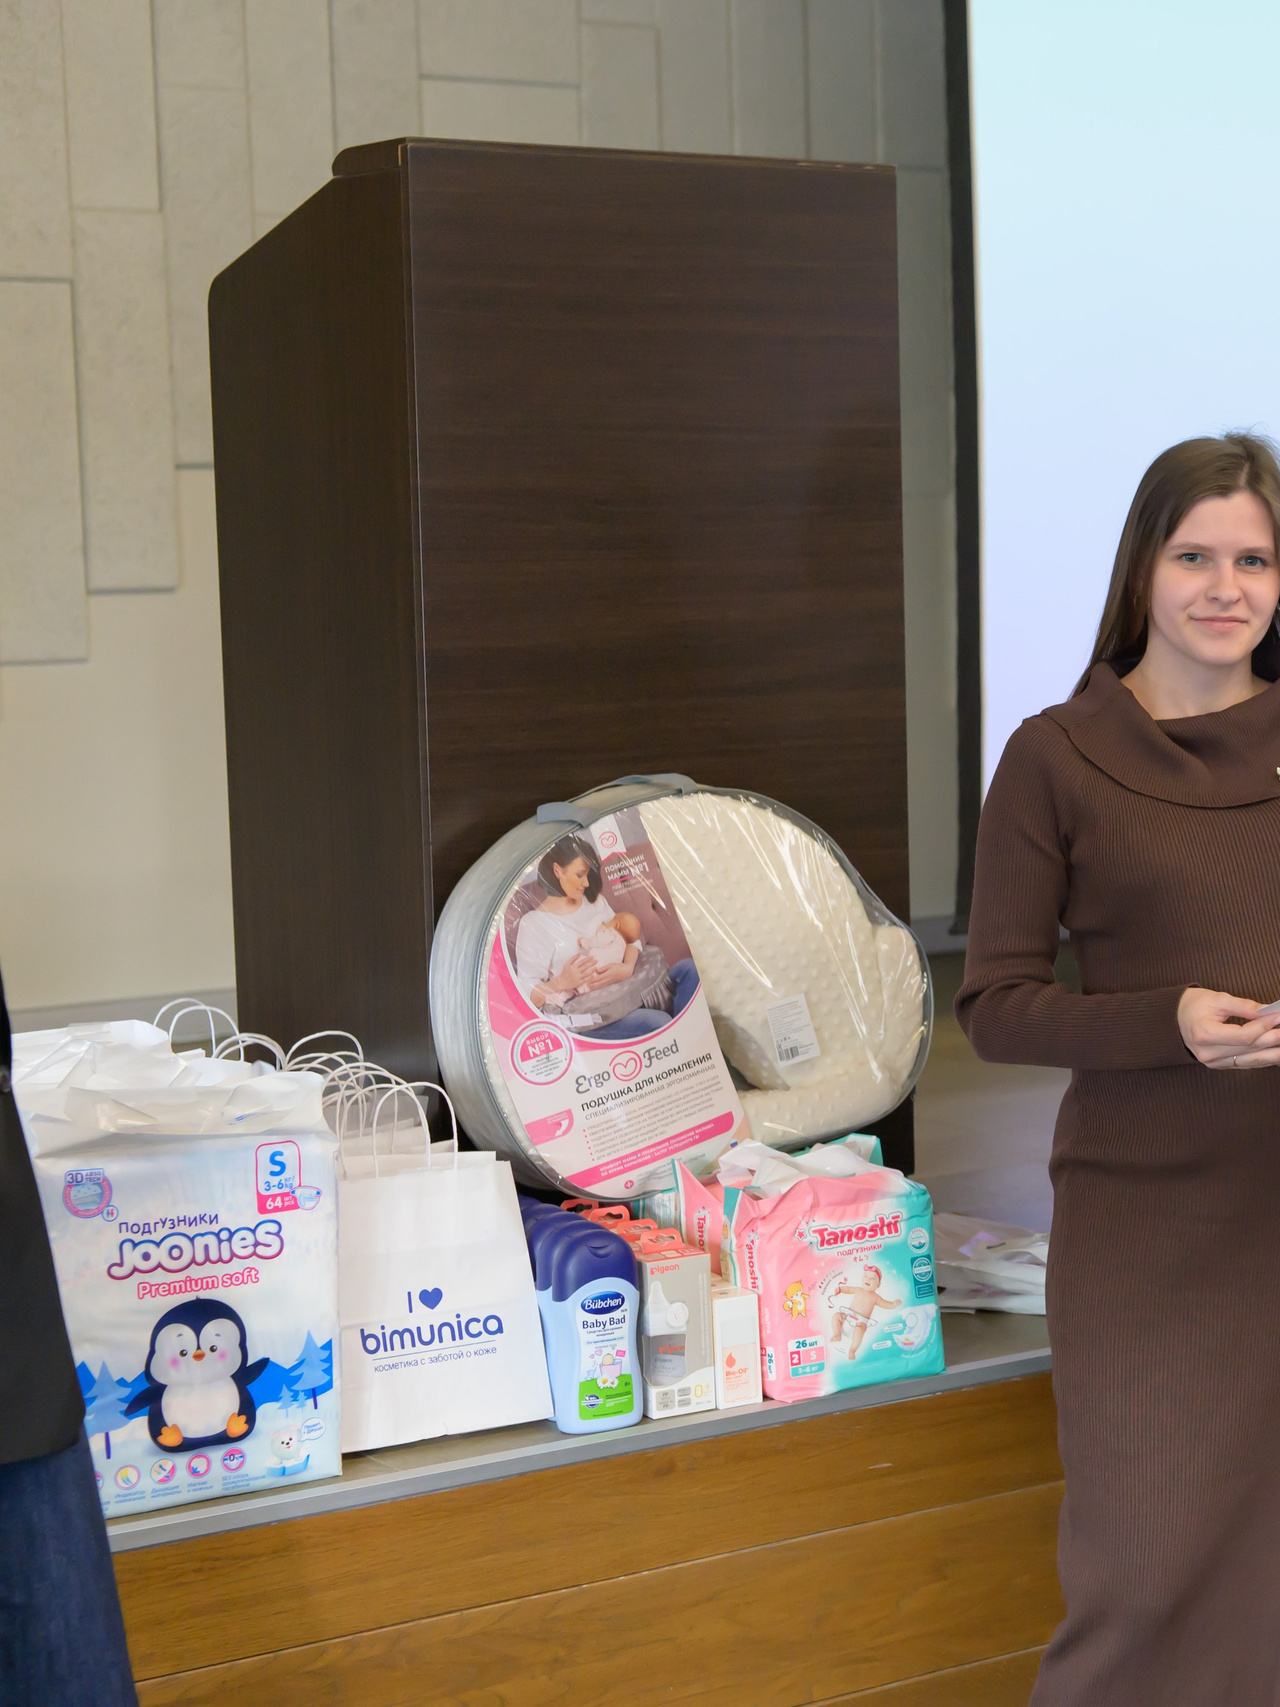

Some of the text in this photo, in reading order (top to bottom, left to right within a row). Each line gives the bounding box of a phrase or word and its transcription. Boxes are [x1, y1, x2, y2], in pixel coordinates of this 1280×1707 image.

[575, 1038, 679, 1095] Ergo Feed
[580, 1085, 633, 1113] ПОДУШКА
[632, 1076, 654, 1091] ДЛЯ
[654, 1052, 712, 1082] КОРМЛЕНИЯ
[584, 1084, 665, 1120] СПЕЦИАЛИЗИРОВАННАЯ
[269, 1150, 286, 1176] S
[67, 1172, 83, 1184] 3D
[264, 1179, 284, 1192] 3-6
[266, 1196, 282, 1210] 64
[836, 1243, 882, 1257] ПОДГУЗНИКИ
[650, 1263, 680, 1275] pigeon
[137, 1267, 259, 1300] Premium soft
[407, 1291, 413, 1313] I
[585, 1297, 622, 1310] Bübchen
[582, 1315, 626, 1330] Baby Bad
[360, 1313, 504, 1355] bimunica
[795, 1339, 807, 1349] 26
[374, 1359, 419, 1373] косметика
[428, 1350, 464, 1364] заботой
[473, 1346, 497, 1356] коже
[767, 1353, 773, 1364] 26
[791, 1353, 799, 1362] 2
[810, 1351, 816, 1359] S
